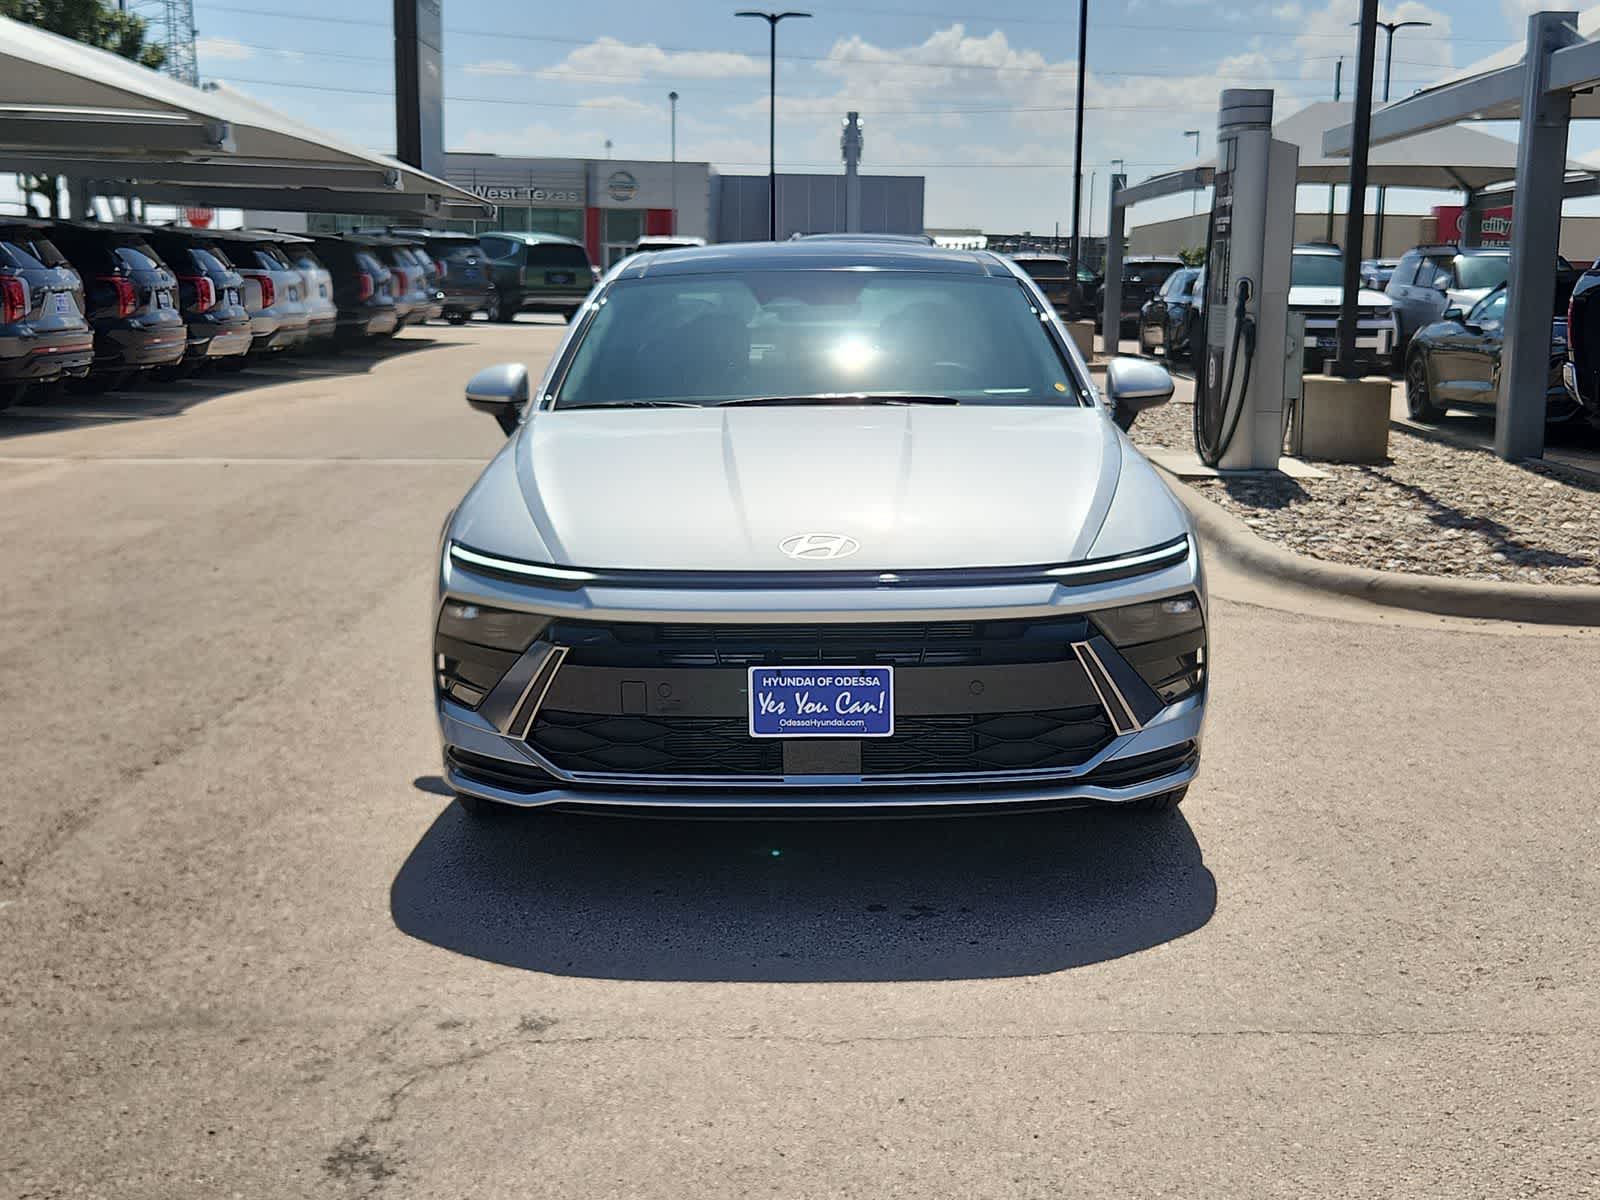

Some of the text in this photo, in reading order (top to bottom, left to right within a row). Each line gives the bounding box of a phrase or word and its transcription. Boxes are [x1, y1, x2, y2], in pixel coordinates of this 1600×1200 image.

[470, 185, 578, 201] West Texas
[762, 676, 881, 687] HYUNDAI OF ODESSA
[758, 691, 886, 715] Yes You Can!
[779, 718, 865, 728] OdessaHyundai.com
